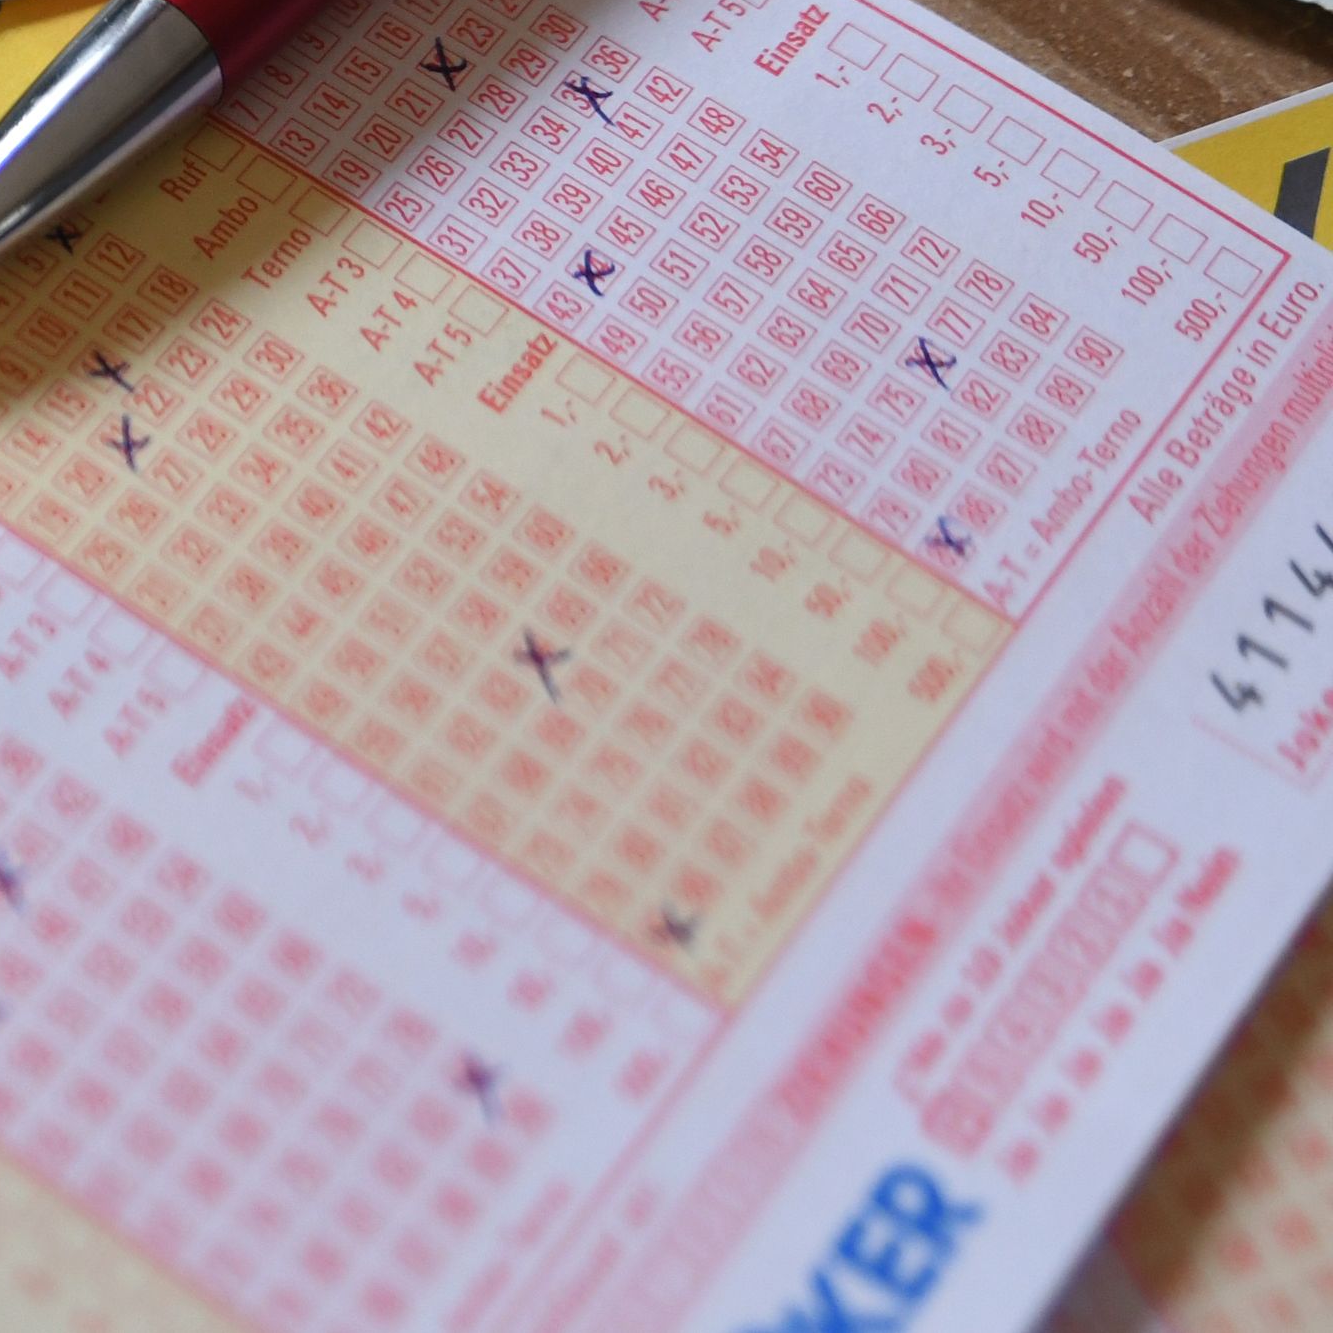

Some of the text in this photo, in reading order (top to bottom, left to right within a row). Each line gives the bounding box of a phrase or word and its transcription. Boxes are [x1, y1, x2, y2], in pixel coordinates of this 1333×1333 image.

[691, 10, 731, 53] A-T
[753, 3, 830, 78] Einsatz
[645, 75, 683, 104] 42
[815, 66, 851, 90] 1,-
[477, 81, 517, 115] 28
[867, 96, 903, 124] 2,-
[750, 138, 788, 170] 54
[920, 128, 957, 156] 3,-
[159, 162, 208, 203] Ruf
[499, 150, 539, 183] 33
[973, 161, 1010, 188] 5,-
[639, 179, 675, 208] 46
[193, 195, 259, 259] Ambo
[772, 208, 812, 240] 59
[856, 203, 896, 235] 66
[1020, 192, 1067, 230] 10,-
[96, 239, 137, 271] 12
[241, 227, 312, 292] Terno
[909, 236, 950, 268] 72
[1073, 226, 1119, 265] 50,-
[149, 272, 189, 304] 18
[306, 258, 366, 317] A-T 3
[1120, 259, 1171, 308] 100,-
[359, 291, 418, 352] A-T 4
[1019, 303, 1057, 335] 84
[1174, 290, 1230, 344] 500,-
[413, 325, 473, 386] A-T 5
[1074, 336, 1113, 368] 90
[477, 333, 558, 416] Einsatz
[1127, 467, 1184, 526] Alle
[1163, 364, 1258, 469] Beträge
[1237, 334, 1278, 366] in
[1258, 278, 1327, 346] Euro.
[1191, 416, 1296, 538] Ziehungen
